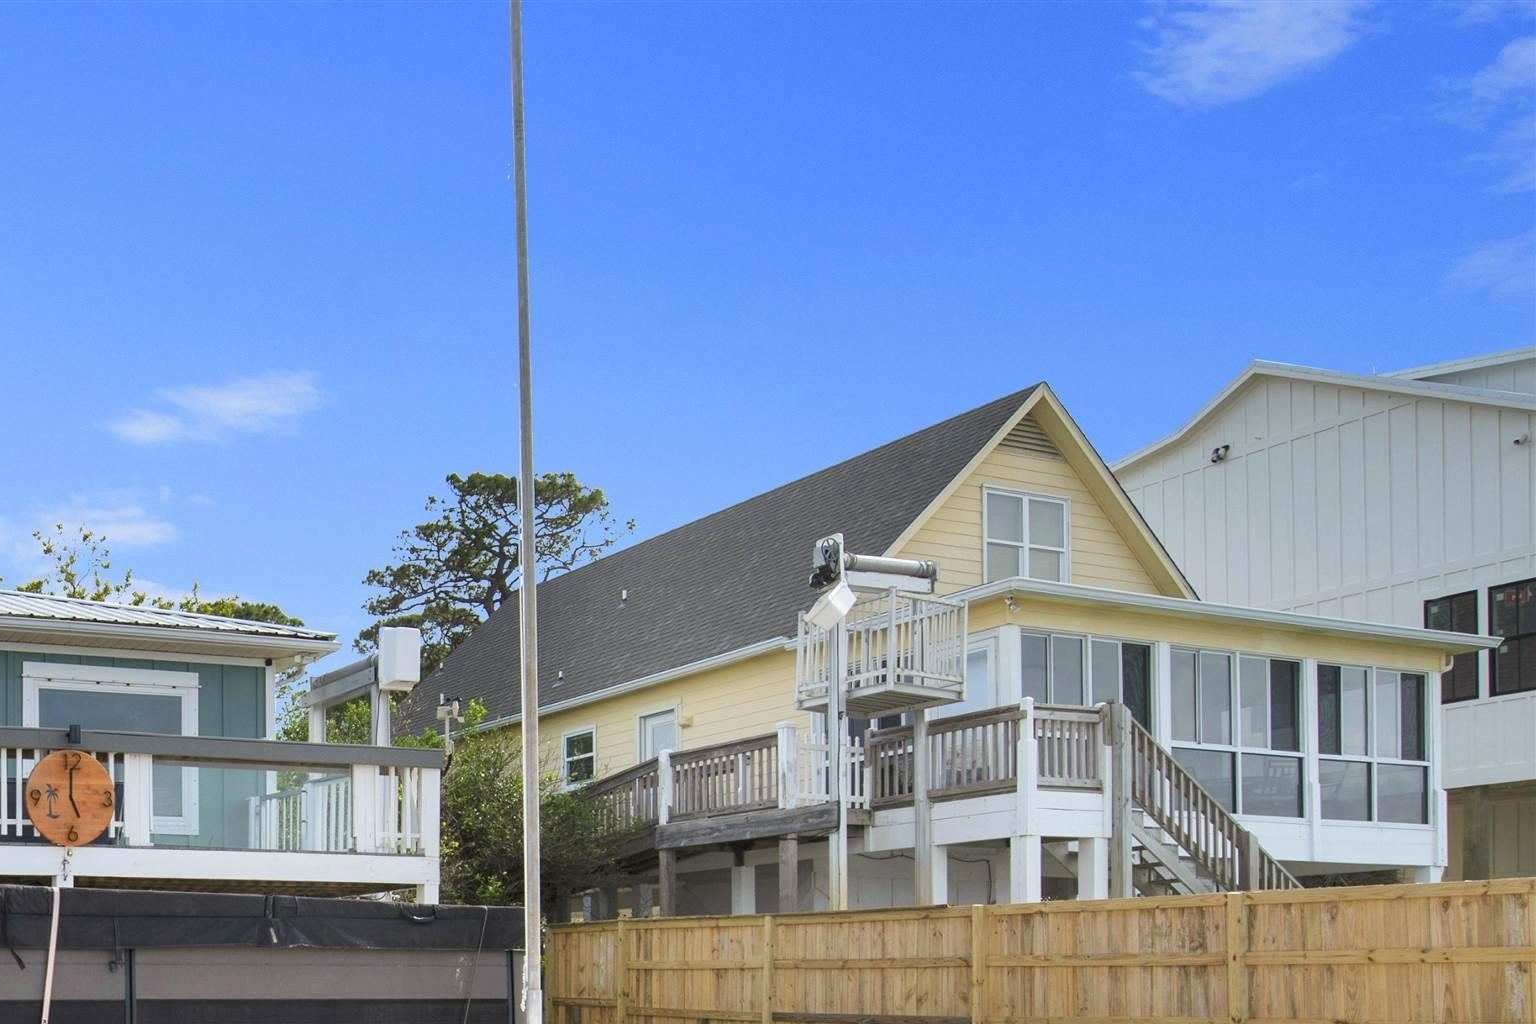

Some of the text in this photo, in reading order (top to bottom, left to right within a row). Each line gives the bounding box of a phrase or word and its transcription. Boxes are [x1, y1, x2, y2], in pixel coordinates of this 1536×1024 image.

[63, 753, 81, 770] 12
[30, 789, 41, 806] 9
[103, 791, 113, 807] 3
[67, 825, 78, 842] 6
